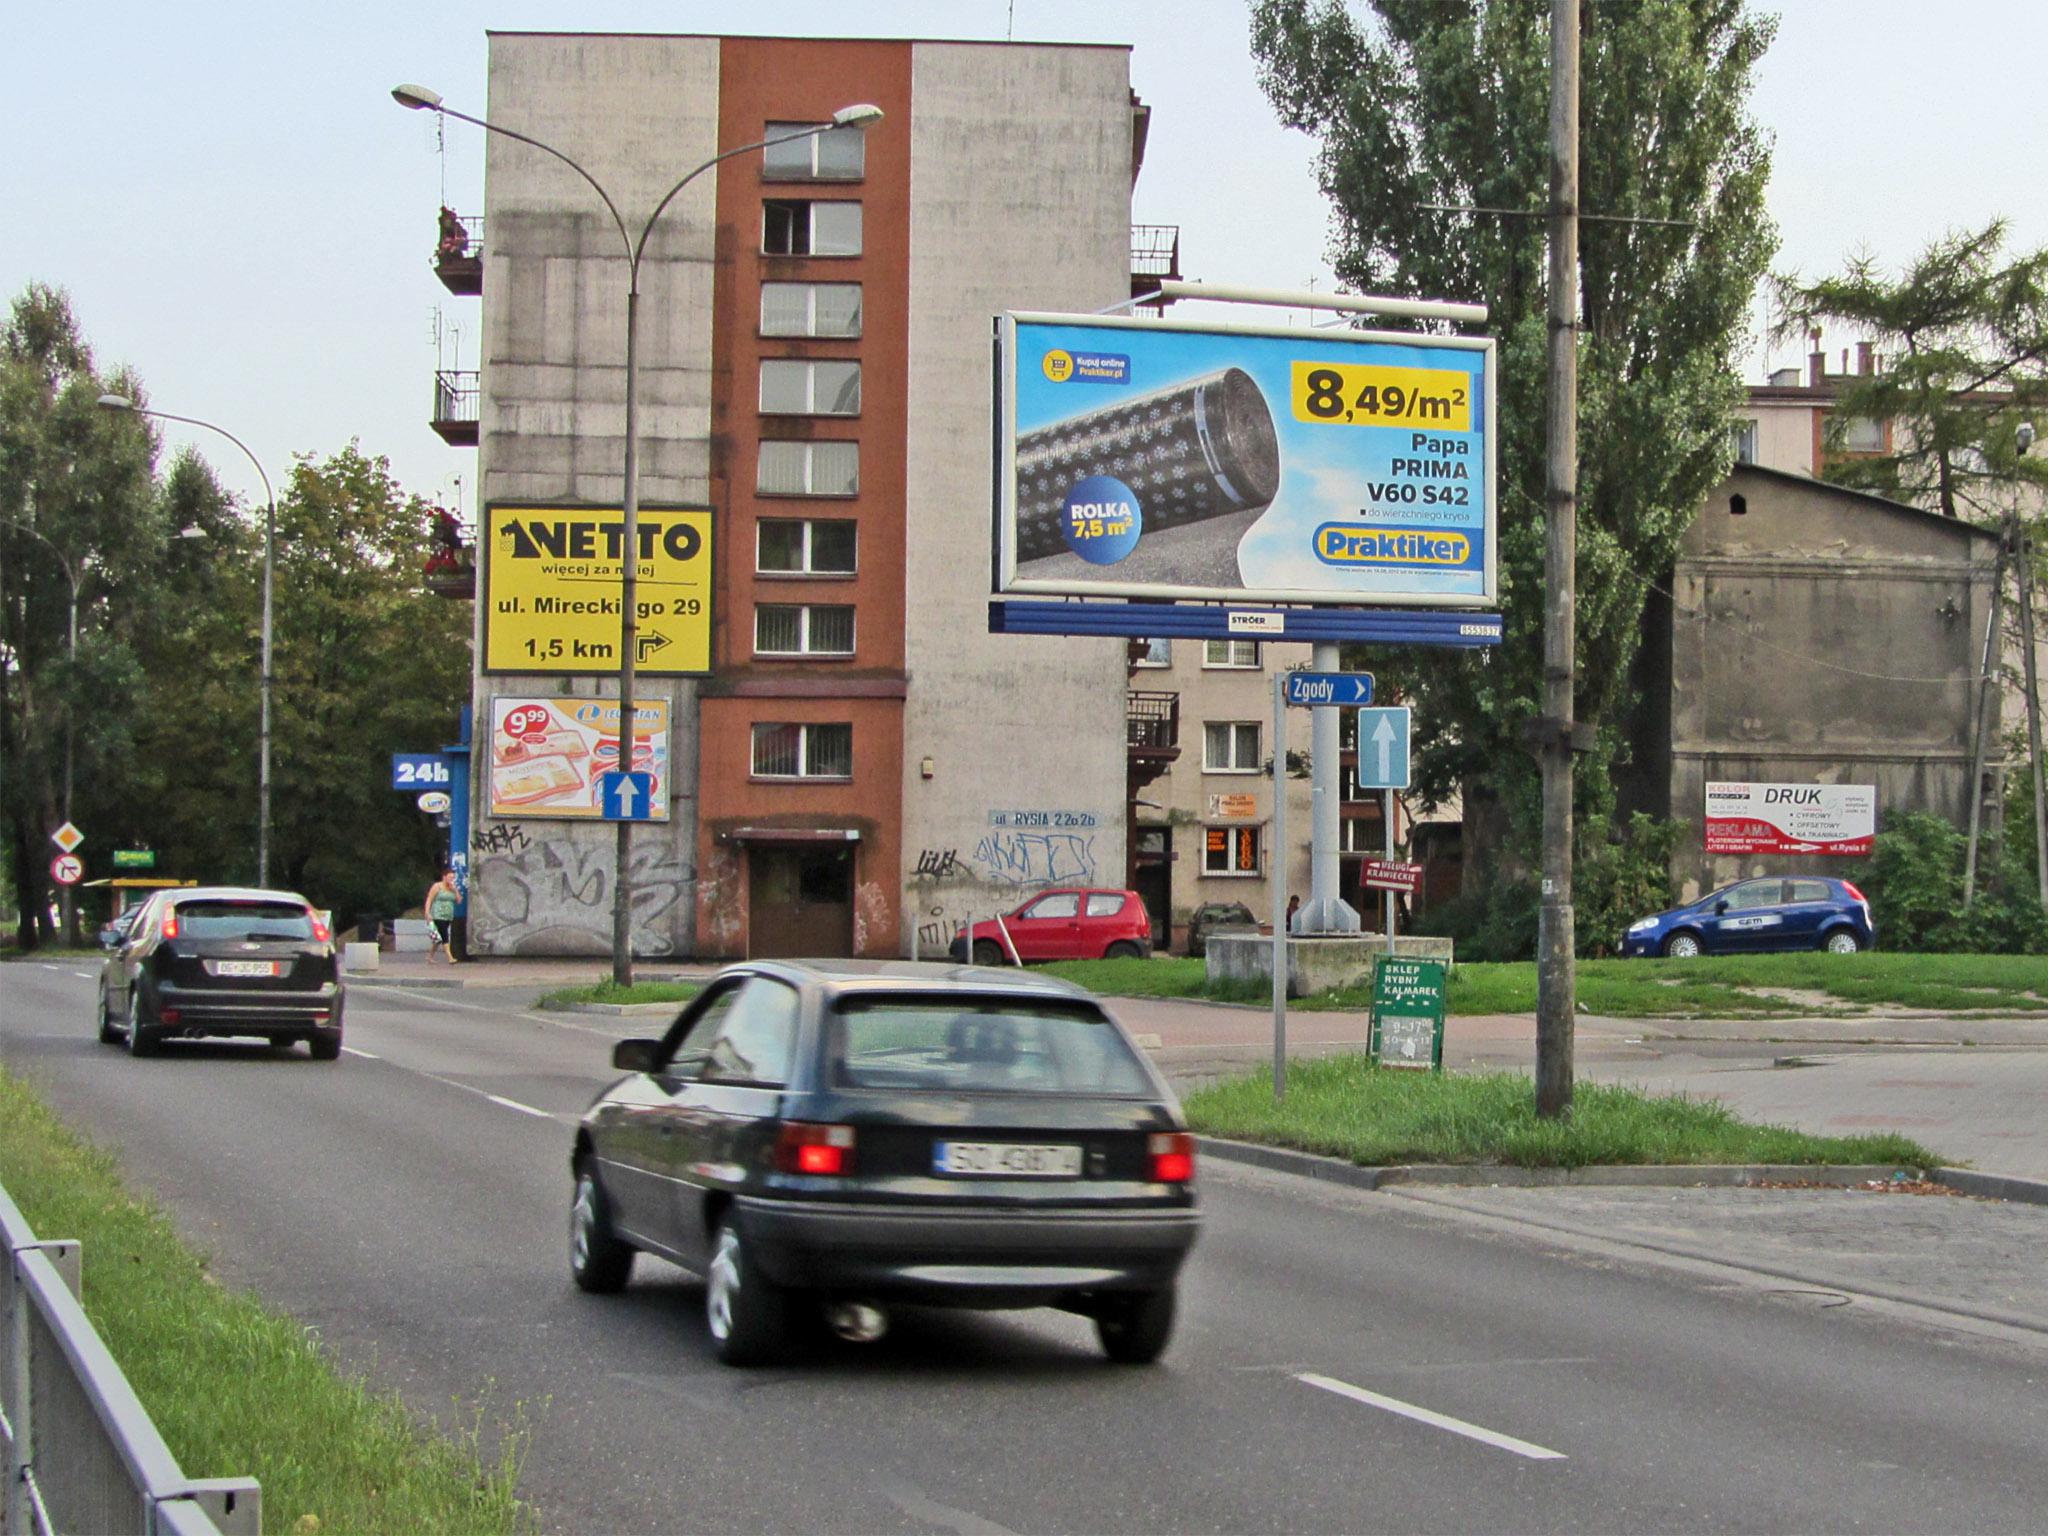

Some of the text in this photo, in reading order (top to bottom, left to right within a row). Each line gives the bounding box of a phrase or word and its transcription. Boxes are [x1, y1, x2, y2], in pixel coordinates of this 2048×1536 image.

[1077, 357, 1125, 368] Kupuj online
[1079, 367, 1123, 378] Praktiker.pl
[1412, 433, 1468, 458] Papa
[1391, 458, 1468, 480] PRIMA
[1367, 482, 1468, 506] V60 S42
[1071, 502, 1132, 520] ROLKA
[1368, 507, 1470, 522] do wierzchniego krycia
[1072, 520, 1104, 540] 7,5
[529, 522, 702, 561] NETTO
[1325, 531, 1465, 562] Praktiker
[541, 565, 655, 578] więcej za miej
[498, 597, 701, 618] ul. Mireckigo 29
[524, 639, 613, 661] 1,5 km
[1293, 678, 1334, 702] Zgody
[397, 762, 449, 782] 24h
[1765, 789, 1822, 805] DRUK
[1015, 812, 1049, 826] RYSIA
[1054, 813, 1062, 826] 2
[1064, 813, 1078, 826] 2a
[1080, 813, 1095, 826] 2b
[1796, 822, 1841, 830] OFFSETOWY
[1707, 824, 1772, 836] REKLAMA
[1381, 861, 1410, 872] USŁUGI
[1367, 869, 1416, 882] KRAWIECKIE
[1385, 965, 1421, 975] SKLEP
[1385, 975, 1420, 985] RYBNY
[1384, 986, 1438, 996] KALMAREK
